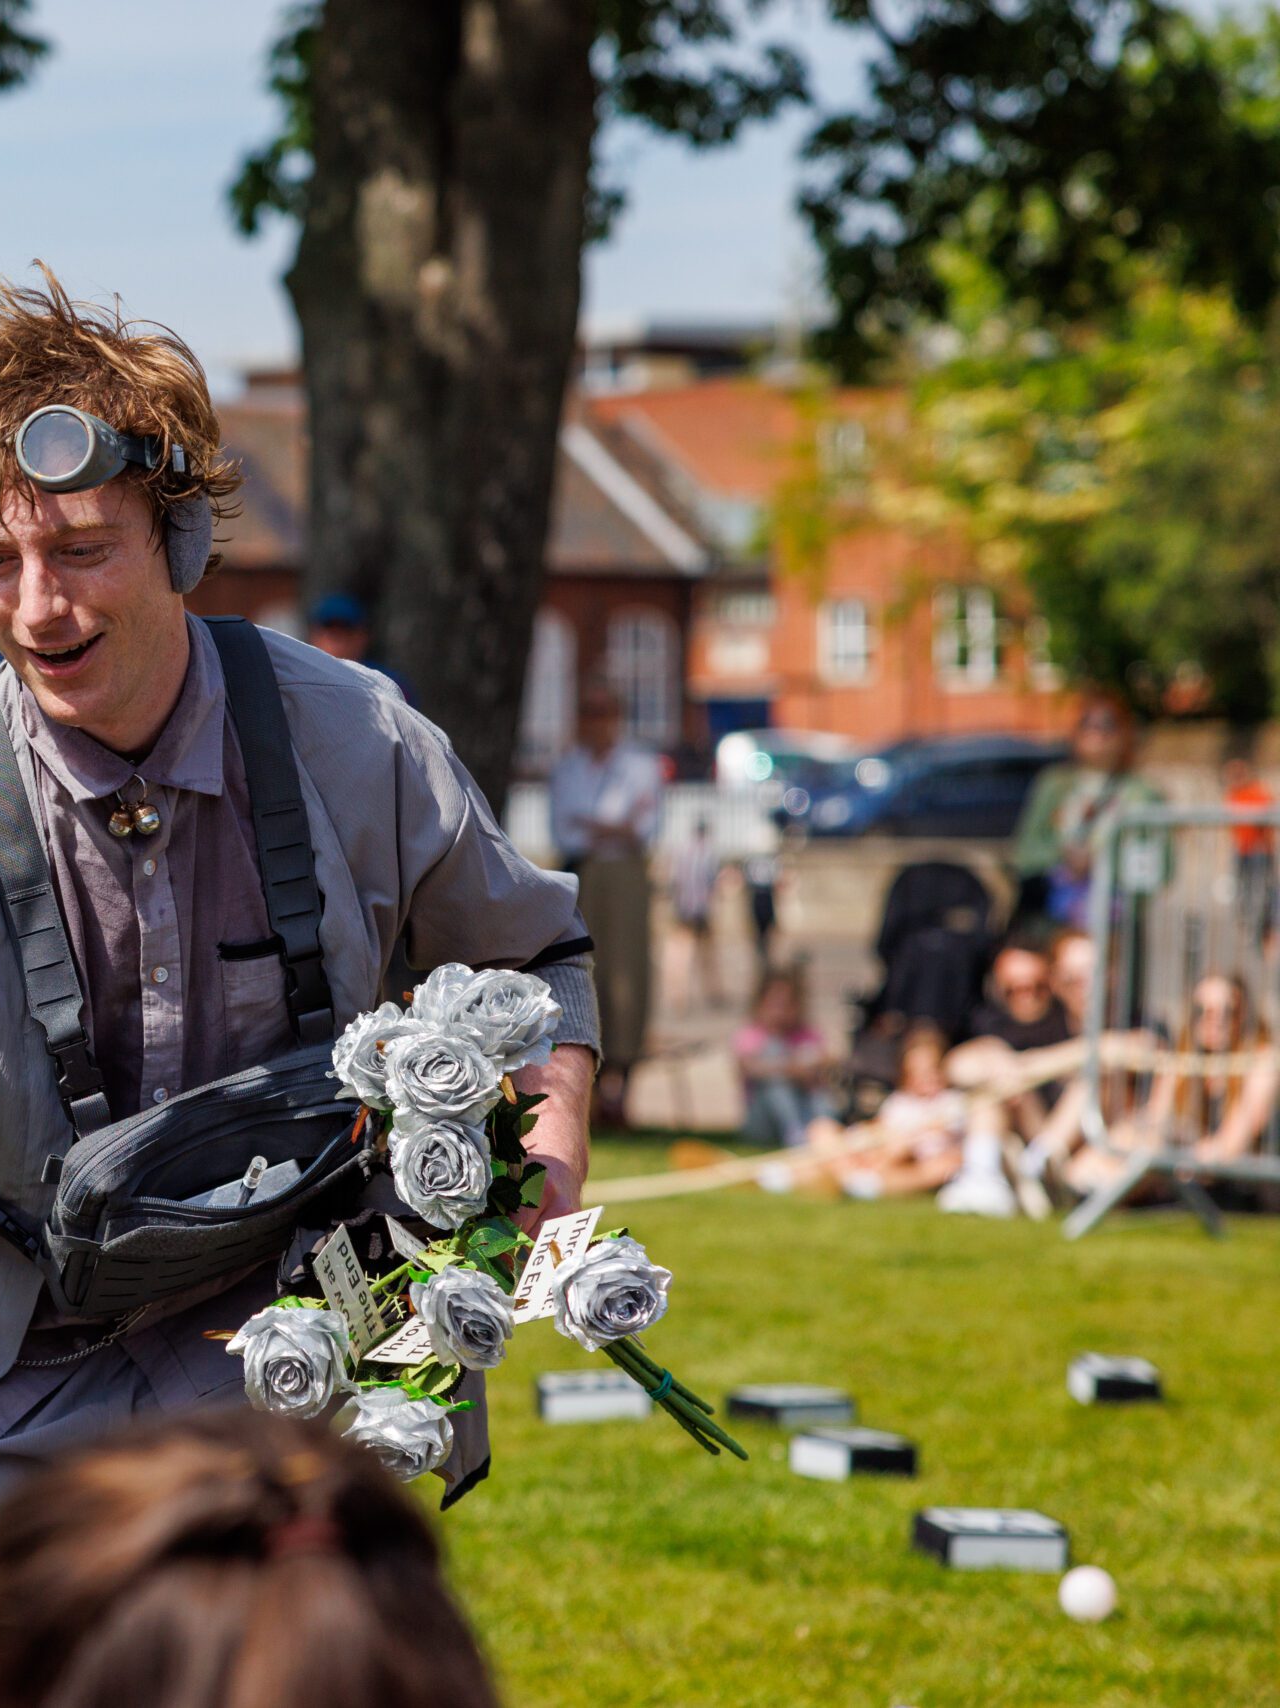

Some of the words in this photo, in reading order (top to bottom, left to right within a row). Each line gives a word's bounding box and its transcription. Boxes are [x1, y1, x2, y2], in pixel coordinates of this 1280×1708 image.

[532, 1227, 560, 1267] The
[565, 1213, 592, 1257] Thr
[321, 1253, 336, 1285] at:
[337, 1240, 361, 1290] End
[358, 1290, 377, 1339] The
[407, 1339, 432, 1358] Th
